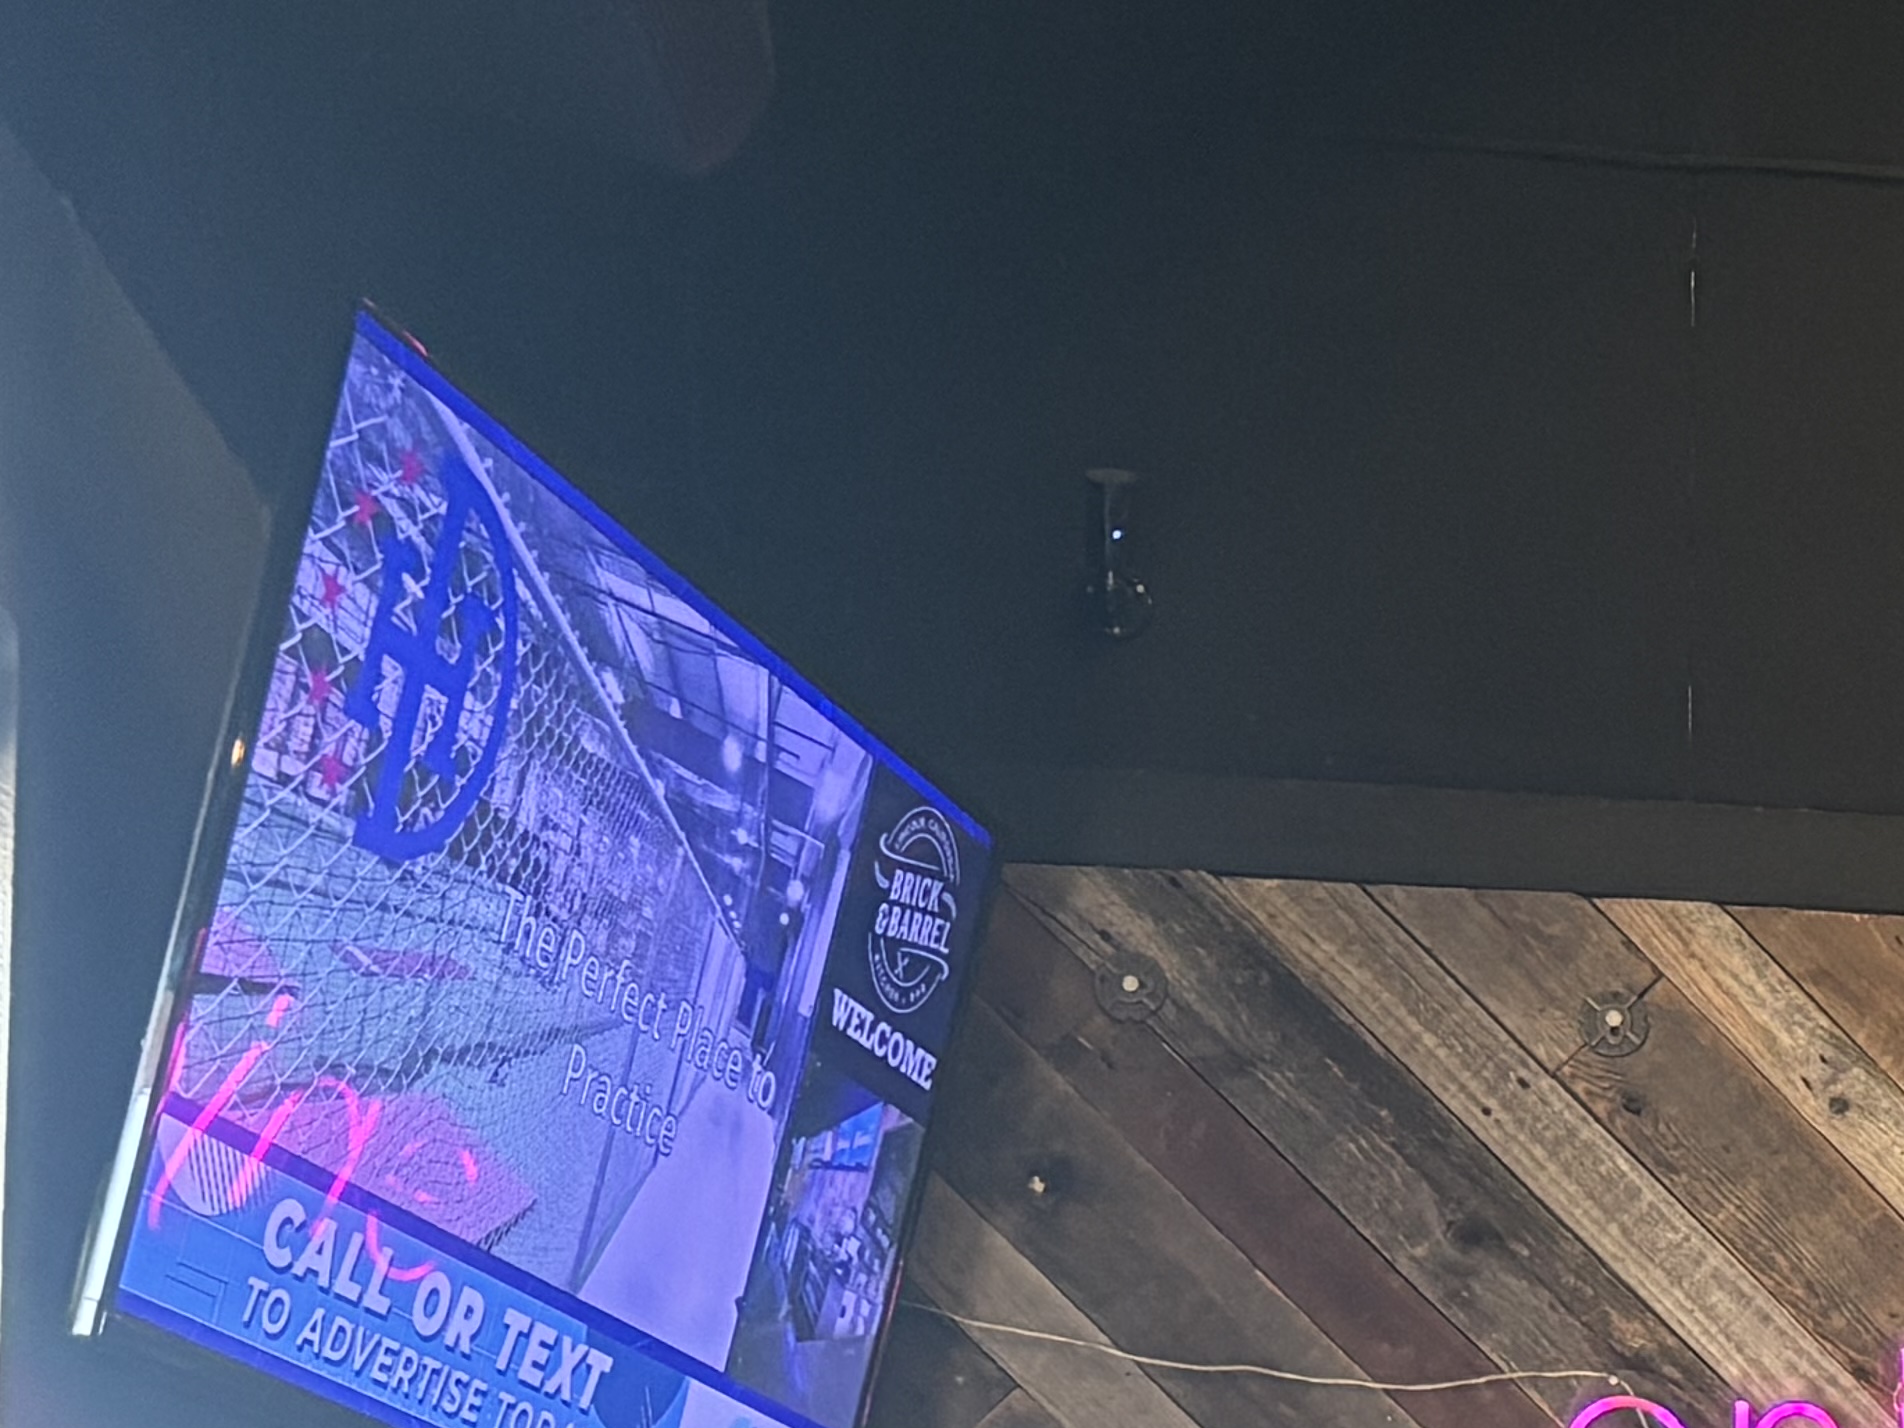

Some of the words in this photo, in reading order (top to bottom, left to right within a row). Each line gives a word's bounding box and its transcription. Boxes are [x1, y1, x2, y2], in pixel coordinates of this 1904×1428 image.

[889, 869, 944, 912] BRICK
[497, 882, 555, 968] The
[561, 929, 667, 1040] Perfect
[670, 1000, 742, 1088] Place
[748, 1053, 776, 1110] to
[831, 987, 937, 1091] WELCOME
[561, 1043, 677, 1155] Practice
[242, 1276, 291, 1335] TO
[296, 1308, 487, 1425] ADVERTISE
[263, 1199, 394, 1316] CALL
[412, 1270, 485, 1356] OR
[495, 1308, 613, 1411] TEXT
